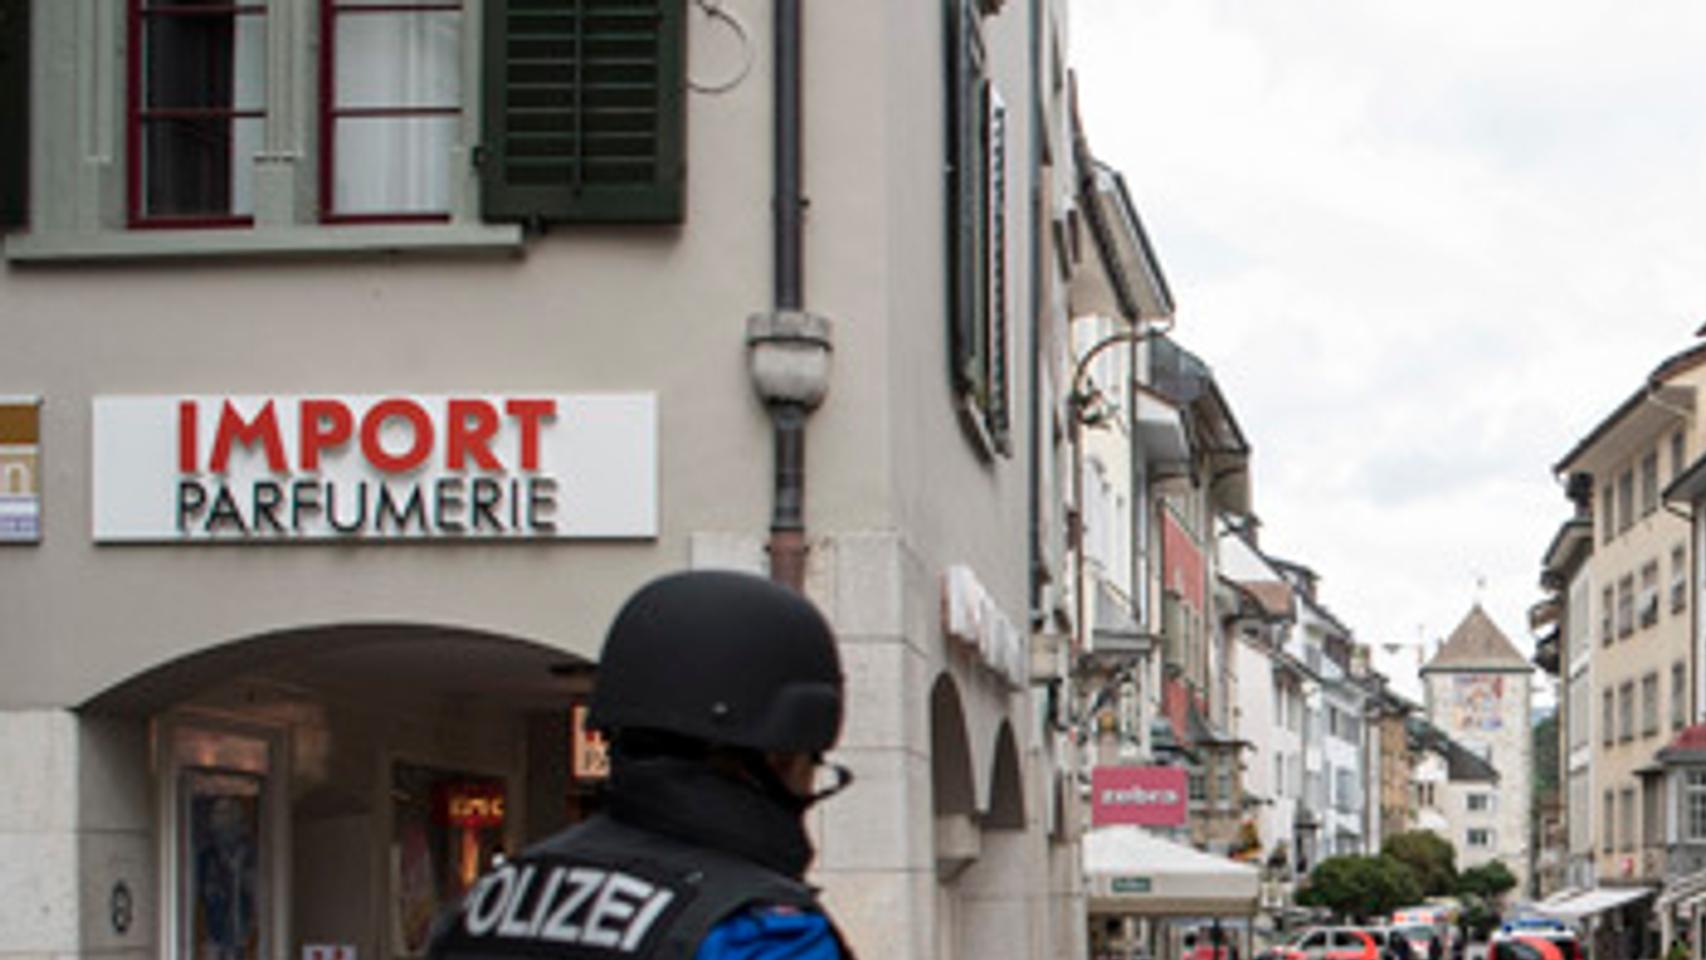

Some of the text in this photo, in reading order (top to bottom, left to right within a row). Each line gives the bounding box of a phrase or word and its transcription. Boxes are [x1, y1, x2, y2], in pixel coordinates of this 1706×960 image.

[178, 399, 557, 473] IMPORT
[178, 480, 556, 531] PARFUMERIE
[462, 866, 674, 951] OLIZEI
